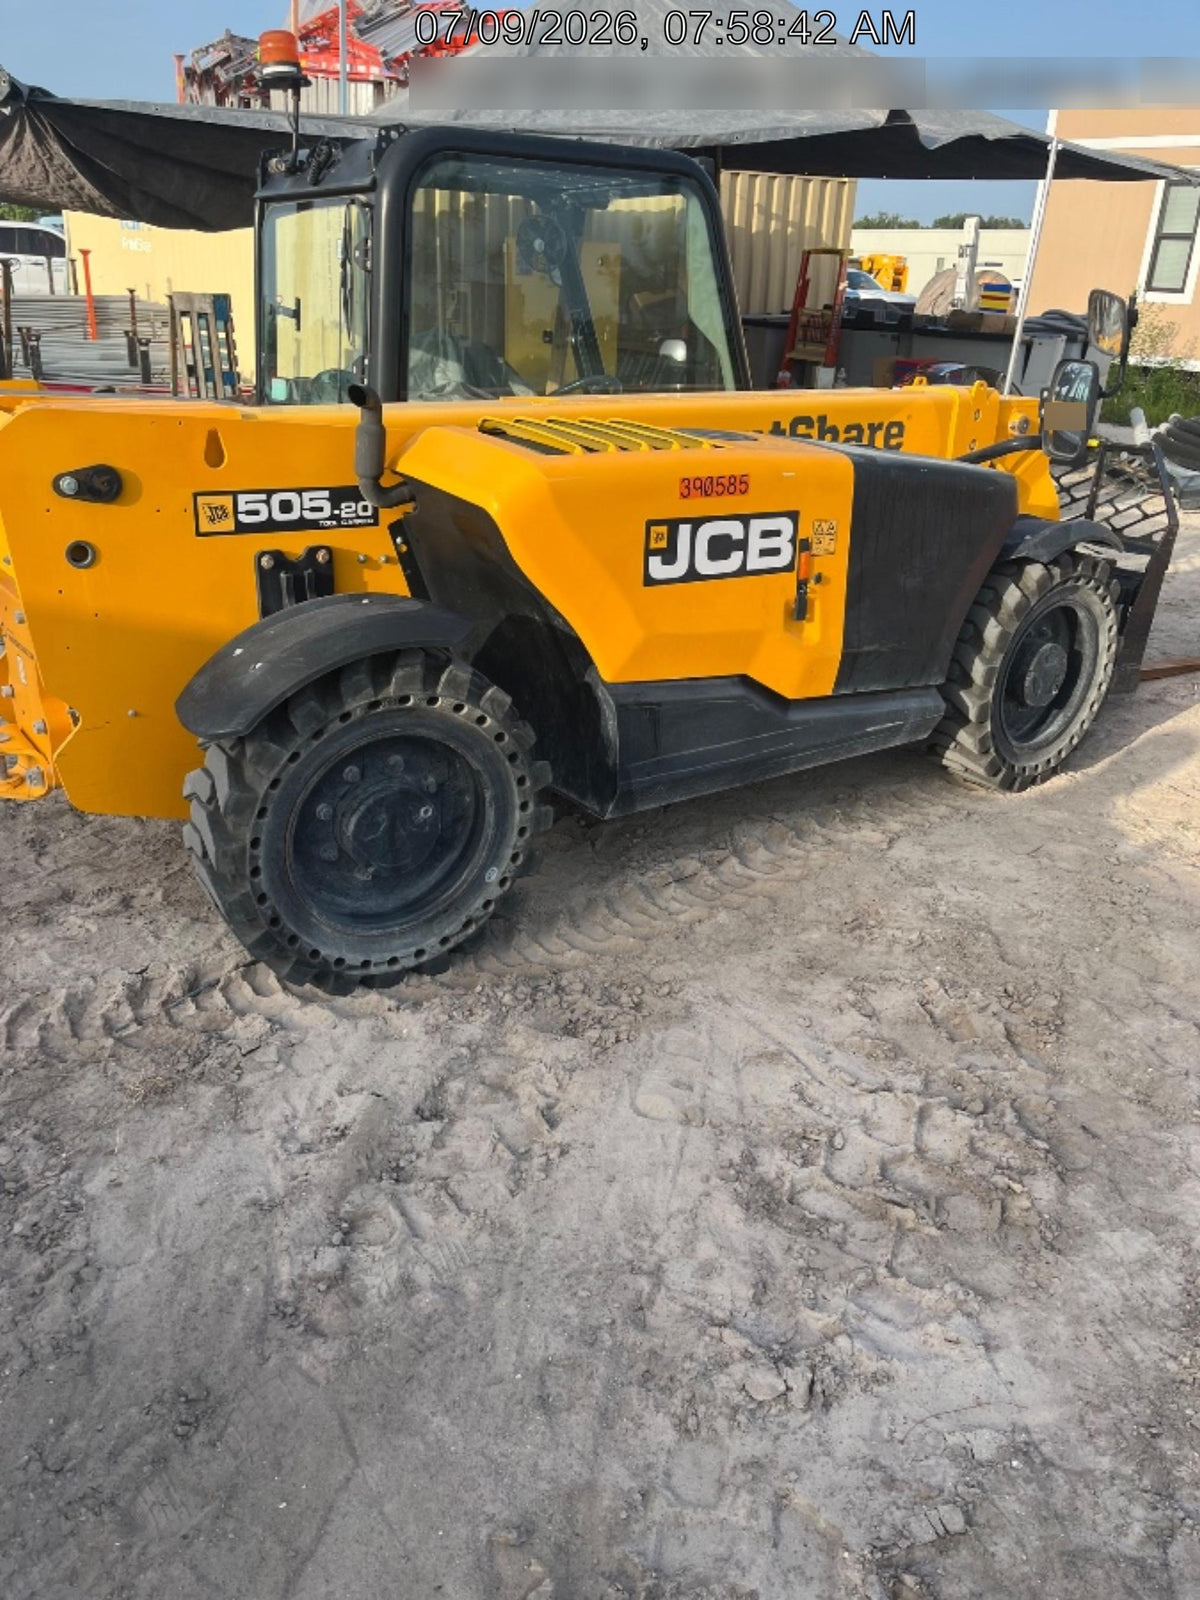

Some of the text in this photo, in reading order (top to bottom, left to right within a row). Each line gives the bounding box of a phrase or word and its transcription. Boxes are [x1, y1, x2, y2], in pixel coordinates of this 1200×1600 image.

[680, 474, 749, 499] 390585
[237, 490, 373, 524] 505-20
[648, 516, 794, 580] JCB
